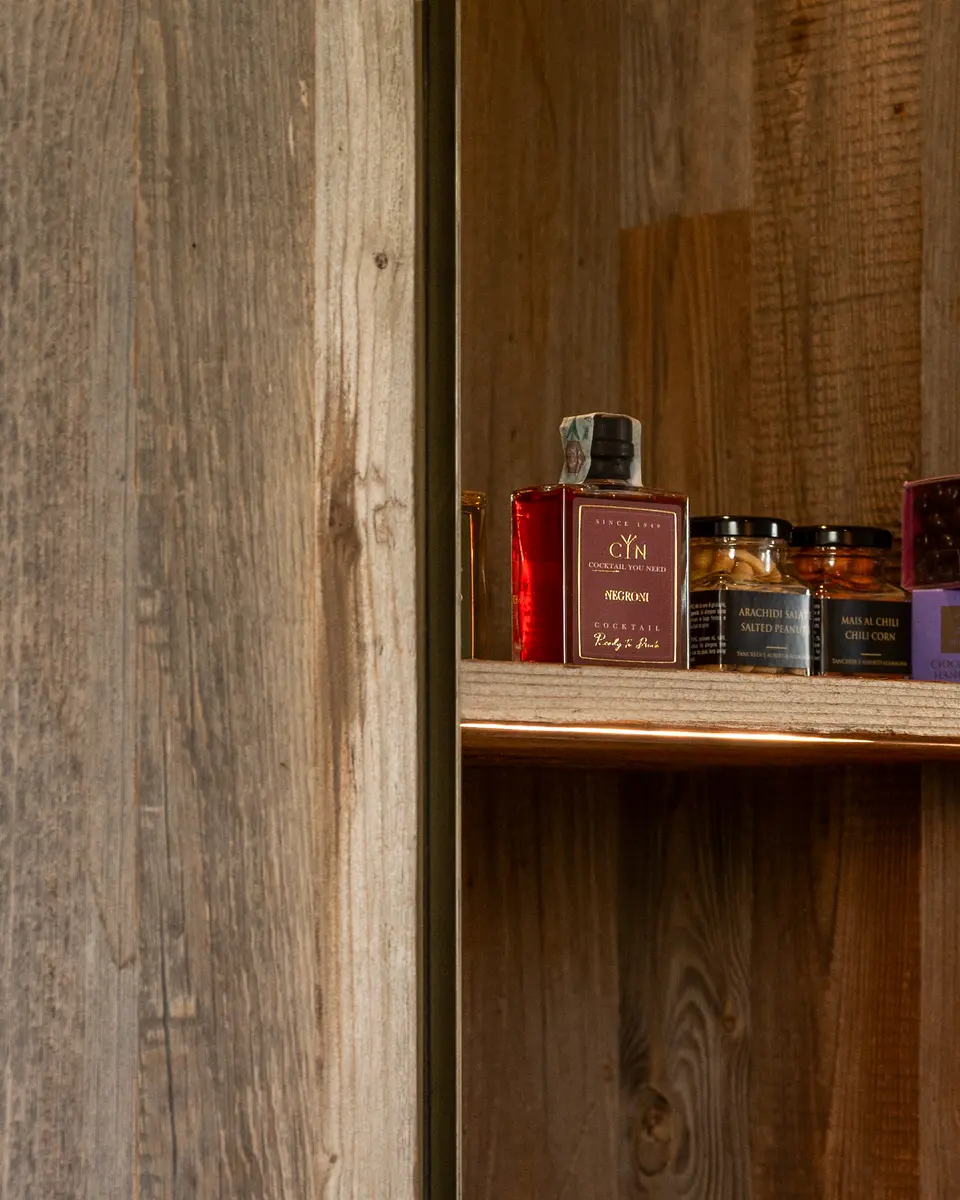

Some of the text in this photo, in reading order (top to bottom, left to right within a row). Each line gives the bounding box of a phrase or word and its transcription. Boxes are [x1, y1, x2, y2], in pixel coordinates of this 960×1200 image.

[595, 518, 629, 527] SINCE
[609, 533, 647, 560] CYN
[588, 561, 627, 570] COCKTAIL
[645, 565, 667, 573] NEED
[604, 589, 650, 603] NEGRONI
[738, 607, 783, 619] ARACHIDI
[594, 621, 661, 632] COCKTAIL
[841, 616, 899, 627] MAIS AL CHILI
[741, 622, 811, 635] SALTED PEANUT
[845, 630, 896, 641] CHILI CORN
[593, 632, 622, 652] Ready
